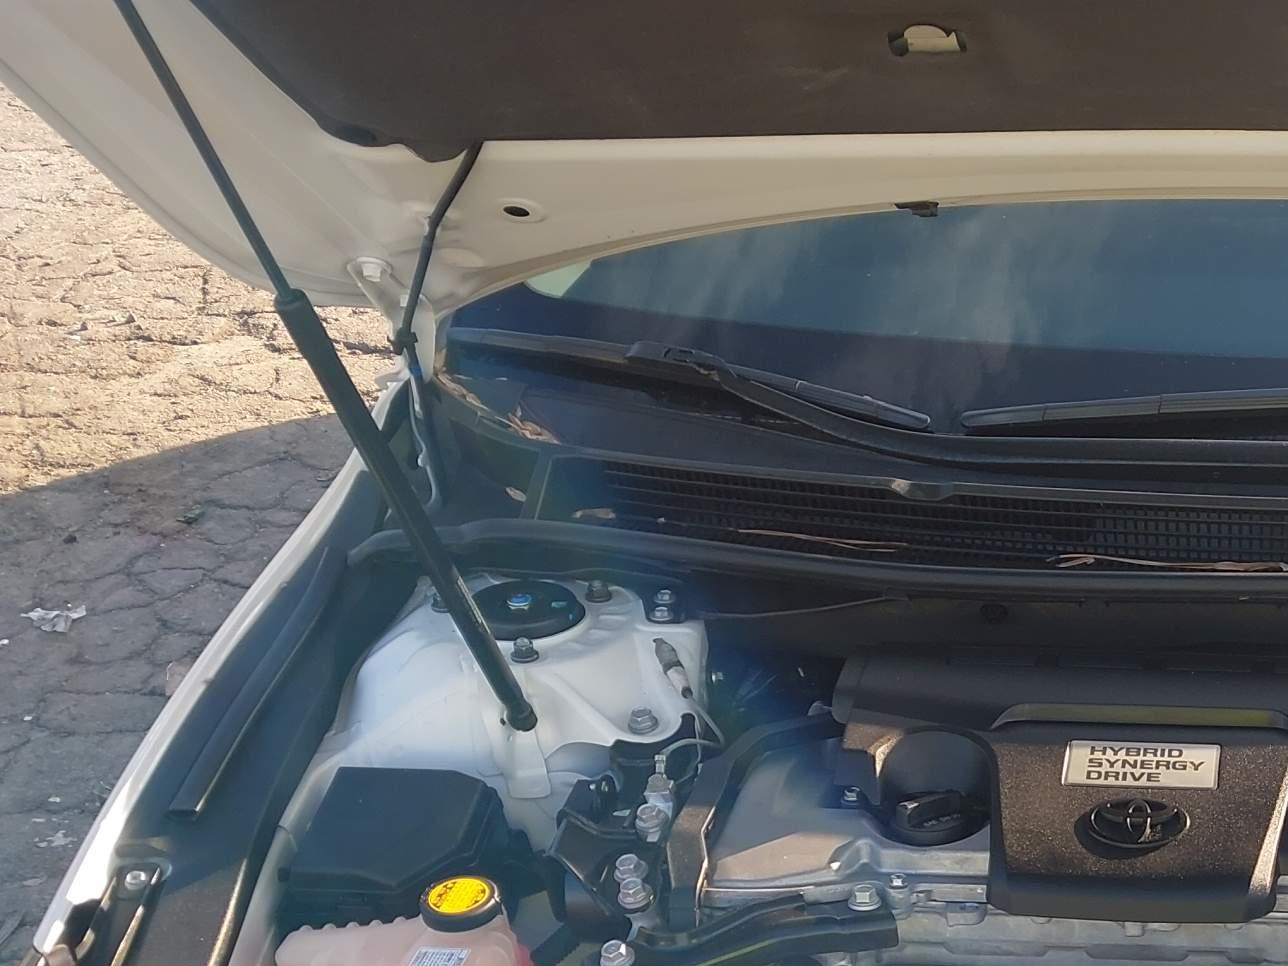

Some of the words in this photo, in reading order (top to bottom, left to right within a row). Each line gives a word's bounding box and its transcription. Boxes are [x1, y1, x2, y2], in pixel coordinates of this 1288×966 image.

[1090, 746, 1183, 758] HYBRID
[1088, 758, 1205, 771] SYNERGY
[1086, 770, 1161, 782] DRIVE
